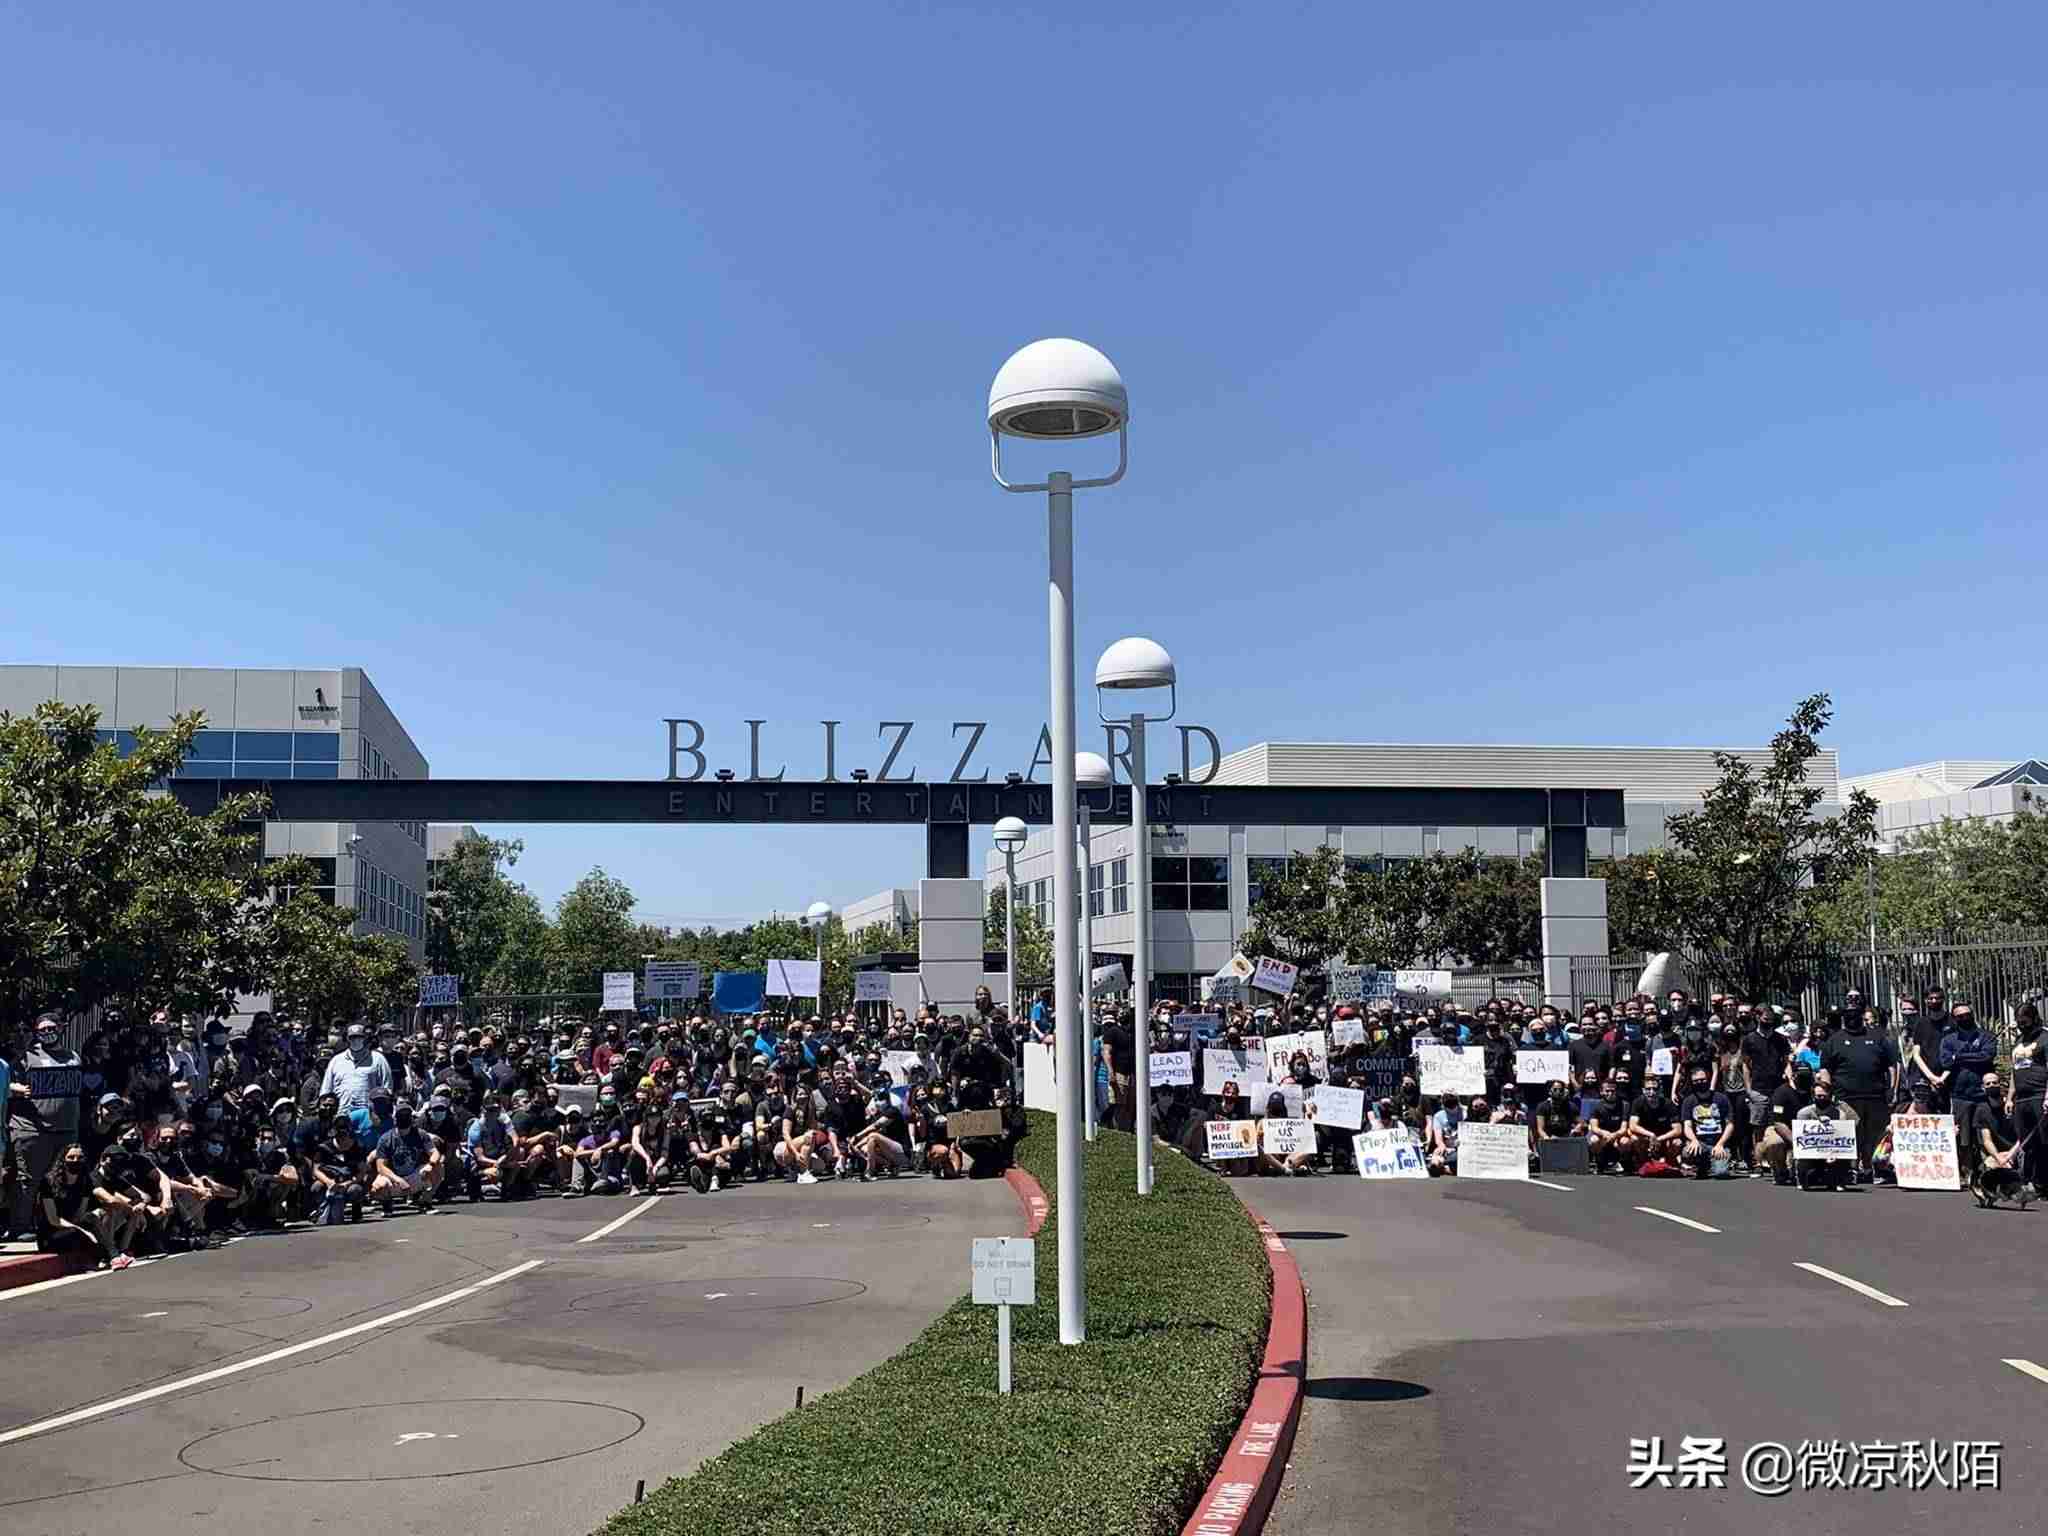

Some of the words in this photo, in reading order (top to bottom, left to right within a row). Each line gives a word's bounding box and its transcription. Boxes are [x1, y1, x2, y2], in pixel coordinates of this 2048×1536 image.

[663, 719, 1221, 784] BLIZZARD
[1153, 1055, 1184, 1067] LEAD
[1356, 1058, 1407, 1072] COMMIT
[31, 1071, 81, 1095] BLIZZARD
[1375, 1071, 1393, 1084] TO
[1897, 1116, 1941, 1129] EVERY
[1278, 1127, 1294, 1137] US
[1898, 1130, 1949, 1144] VOICE
[1359, 1132, 1387, 1151] Play
[1363, 1157, 1395, 1175] Play
[1395, 1146, 1424, 1170] Fair!
[1203, 1482, 1255, 1521] PARKING
